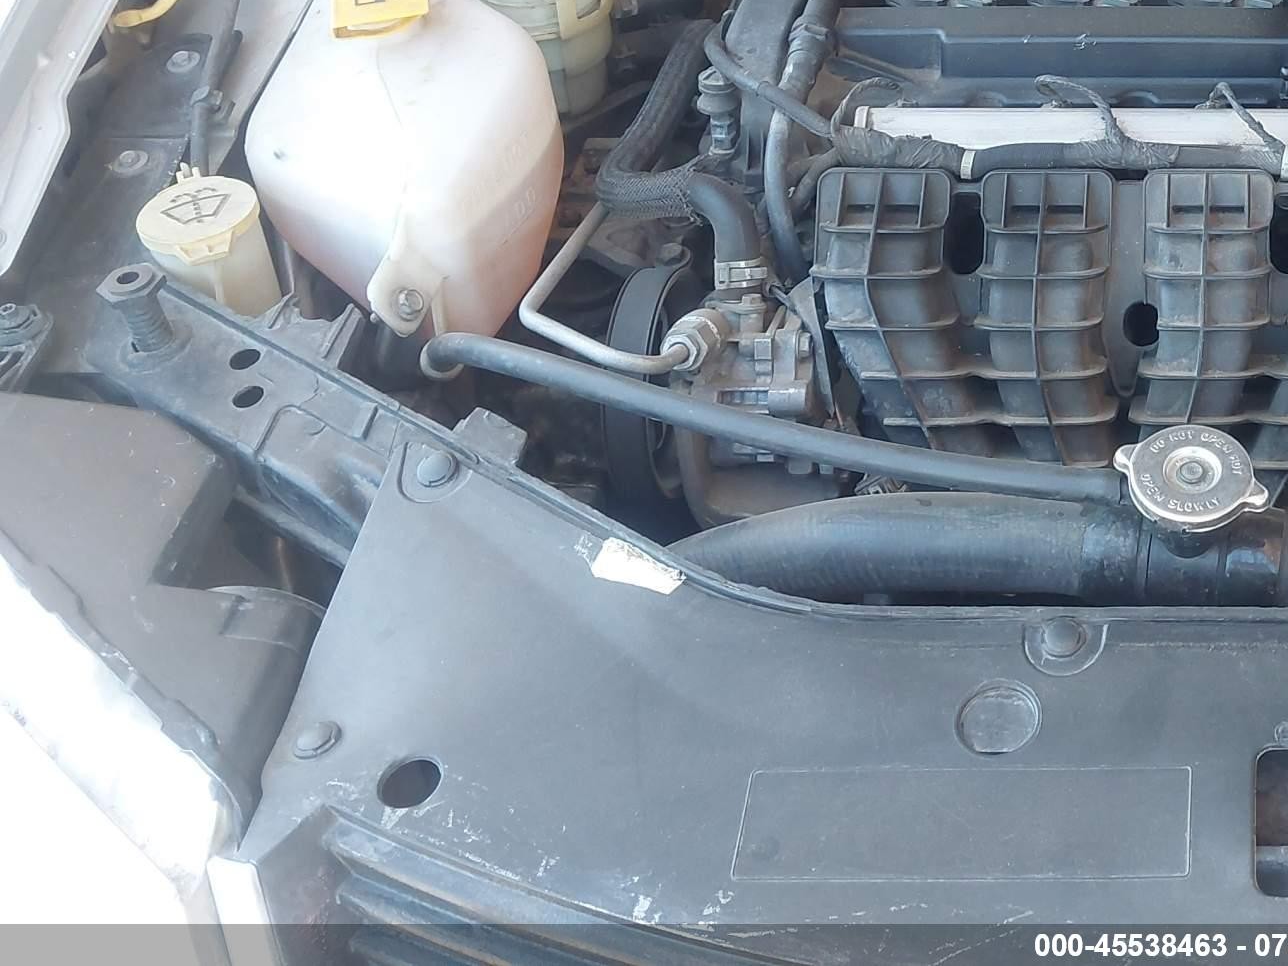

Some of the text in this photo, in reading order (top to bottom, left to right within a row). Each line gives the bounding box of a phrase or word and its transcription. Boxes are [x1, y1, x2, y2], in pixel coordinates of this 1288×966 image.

[1149, 439, 1165, 454] DO
[1168, 430, 1196, 442] NOT
[1200, 432, 1233, 454] OPEN
[1139, 473, 1221, 512] OPEN SLOWLY
